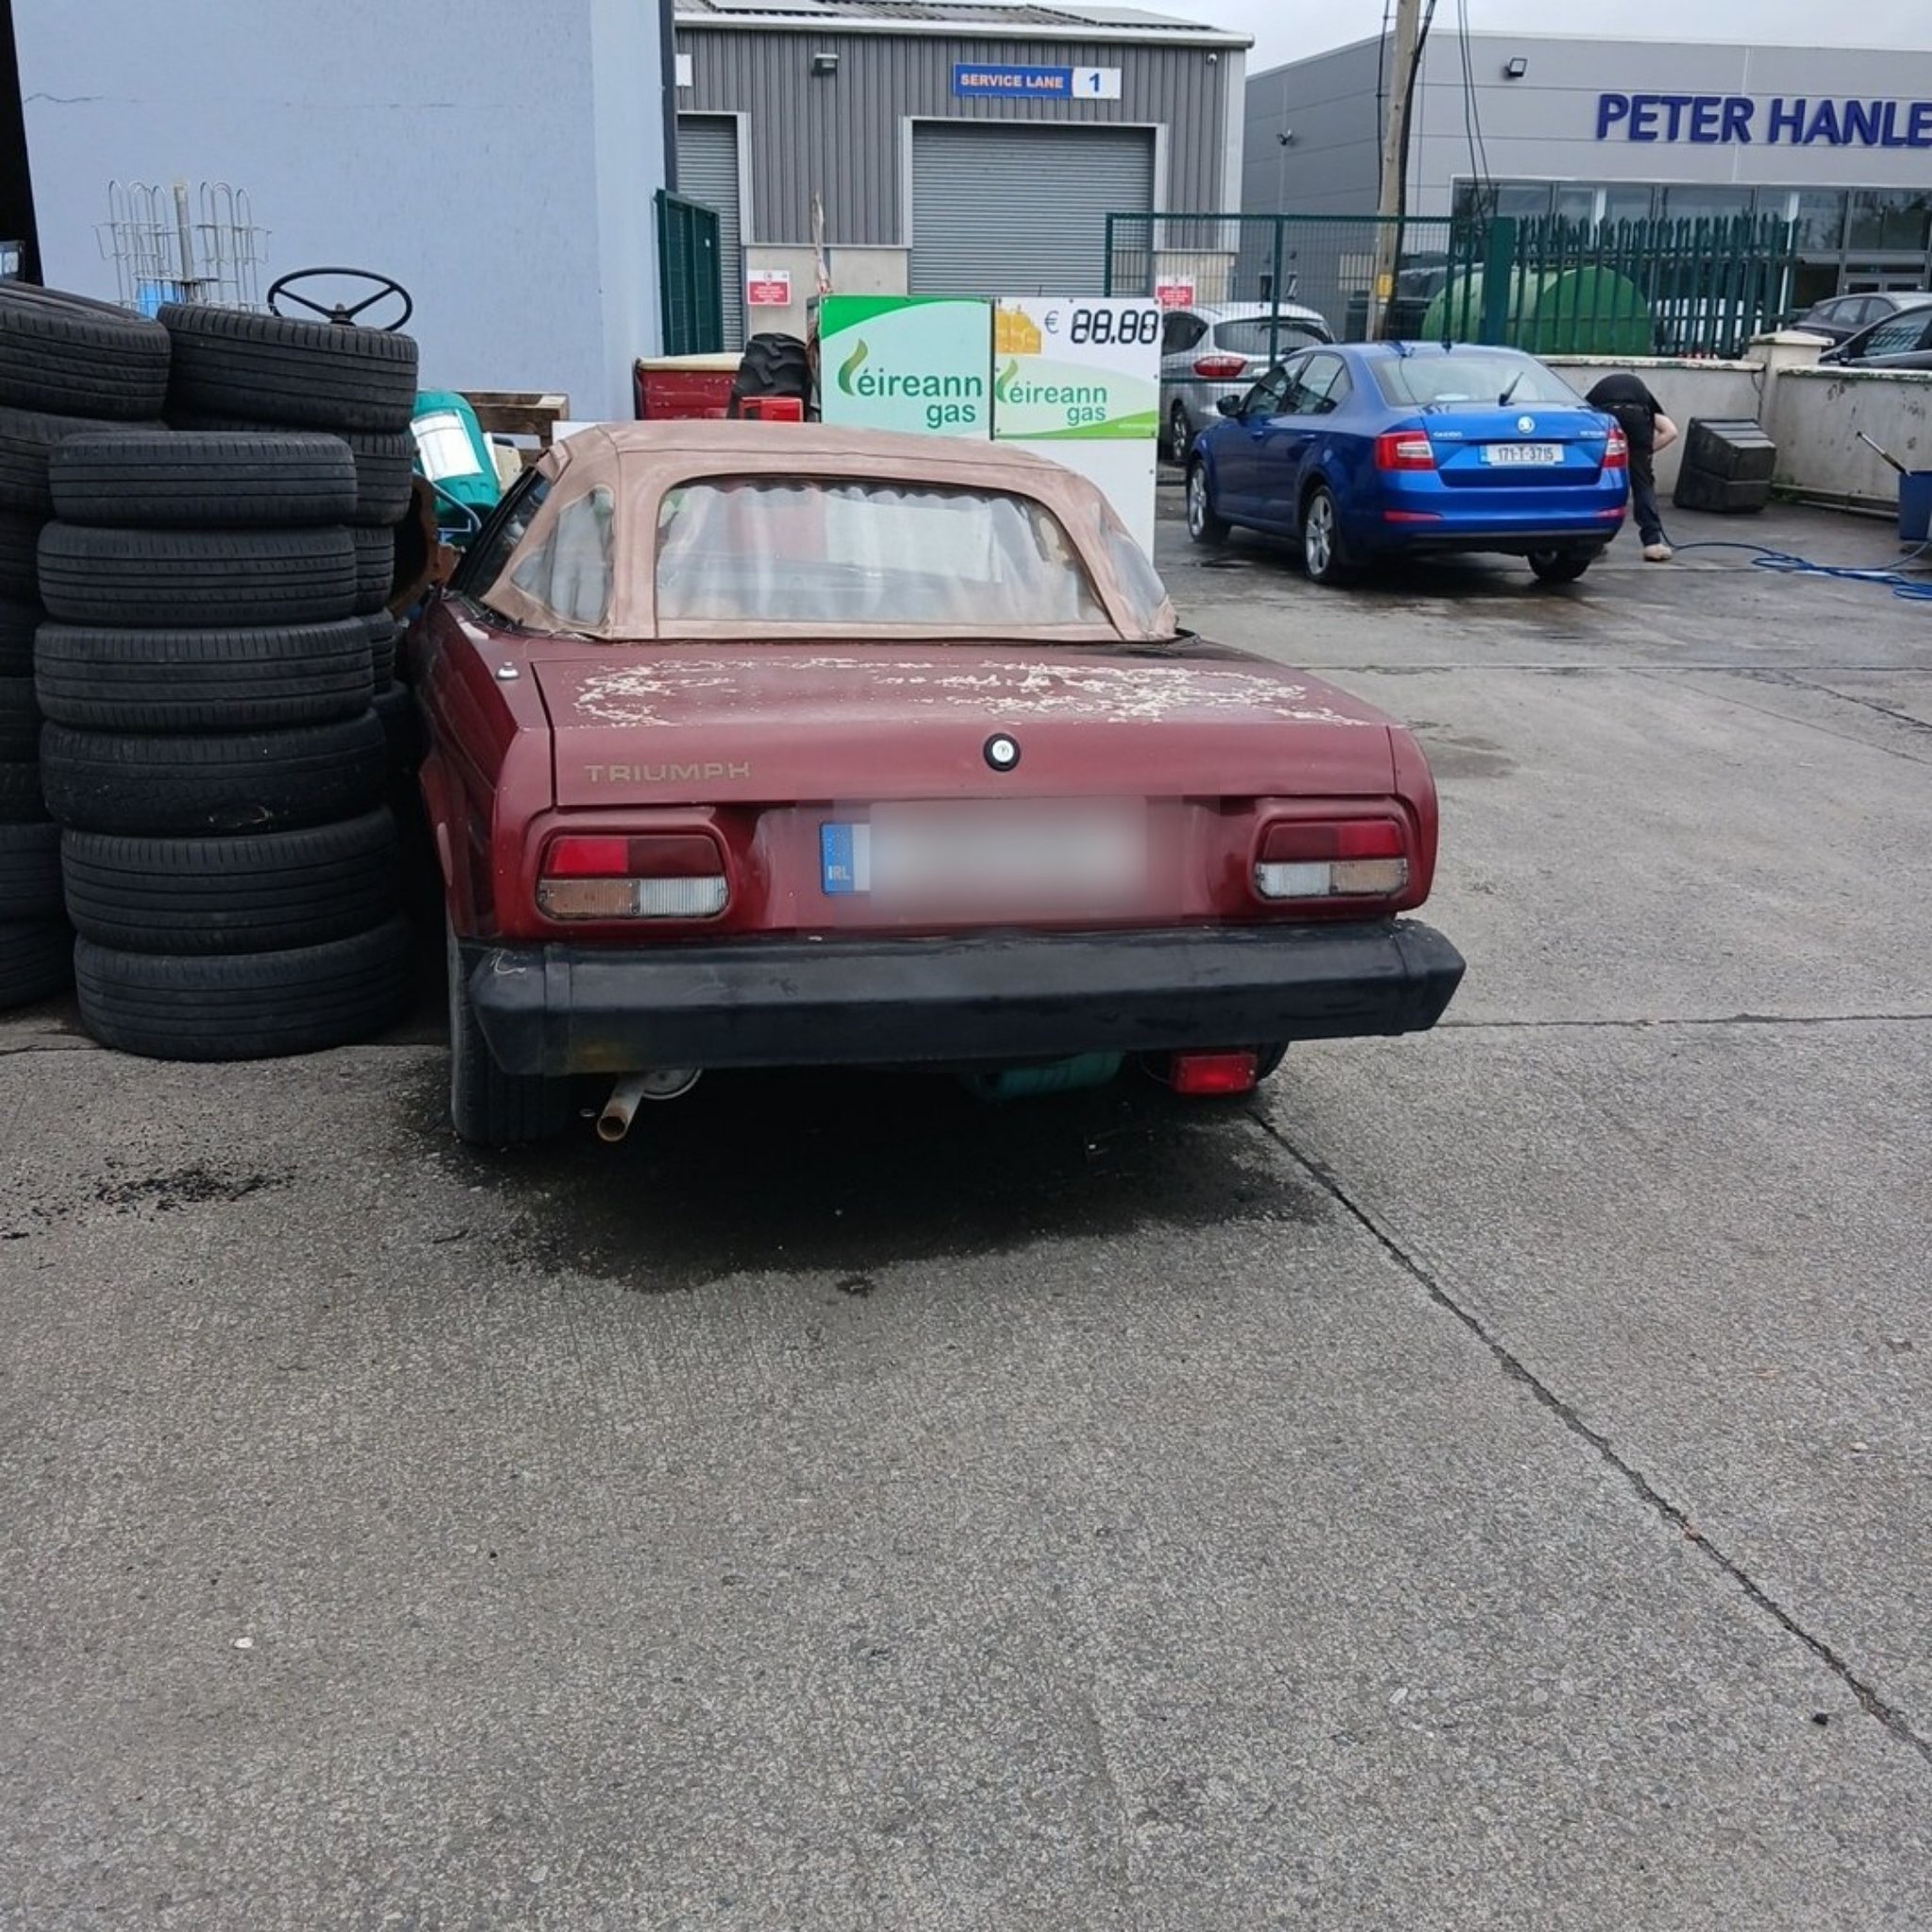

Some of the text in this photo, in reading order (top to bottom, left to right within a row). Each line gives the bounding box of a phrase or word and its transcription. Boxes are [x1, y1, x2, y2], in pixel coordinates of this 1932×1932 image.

[960, 72, 1101, 92] SERVICE LANE 1
[1596, 92, 1932, 147] PETER HANLE
[1043, 308, 1160, 345] € 88.88
[857, 367, 983, 398] éireann
[1008, 380, 1108, 404] éireann
[925, 404, 976, 429] gas
[1066, 406, 1107, 426] gas
[583, 760, 751, 784] TRIUMPH
[827, 864, 851, 881] IRL
